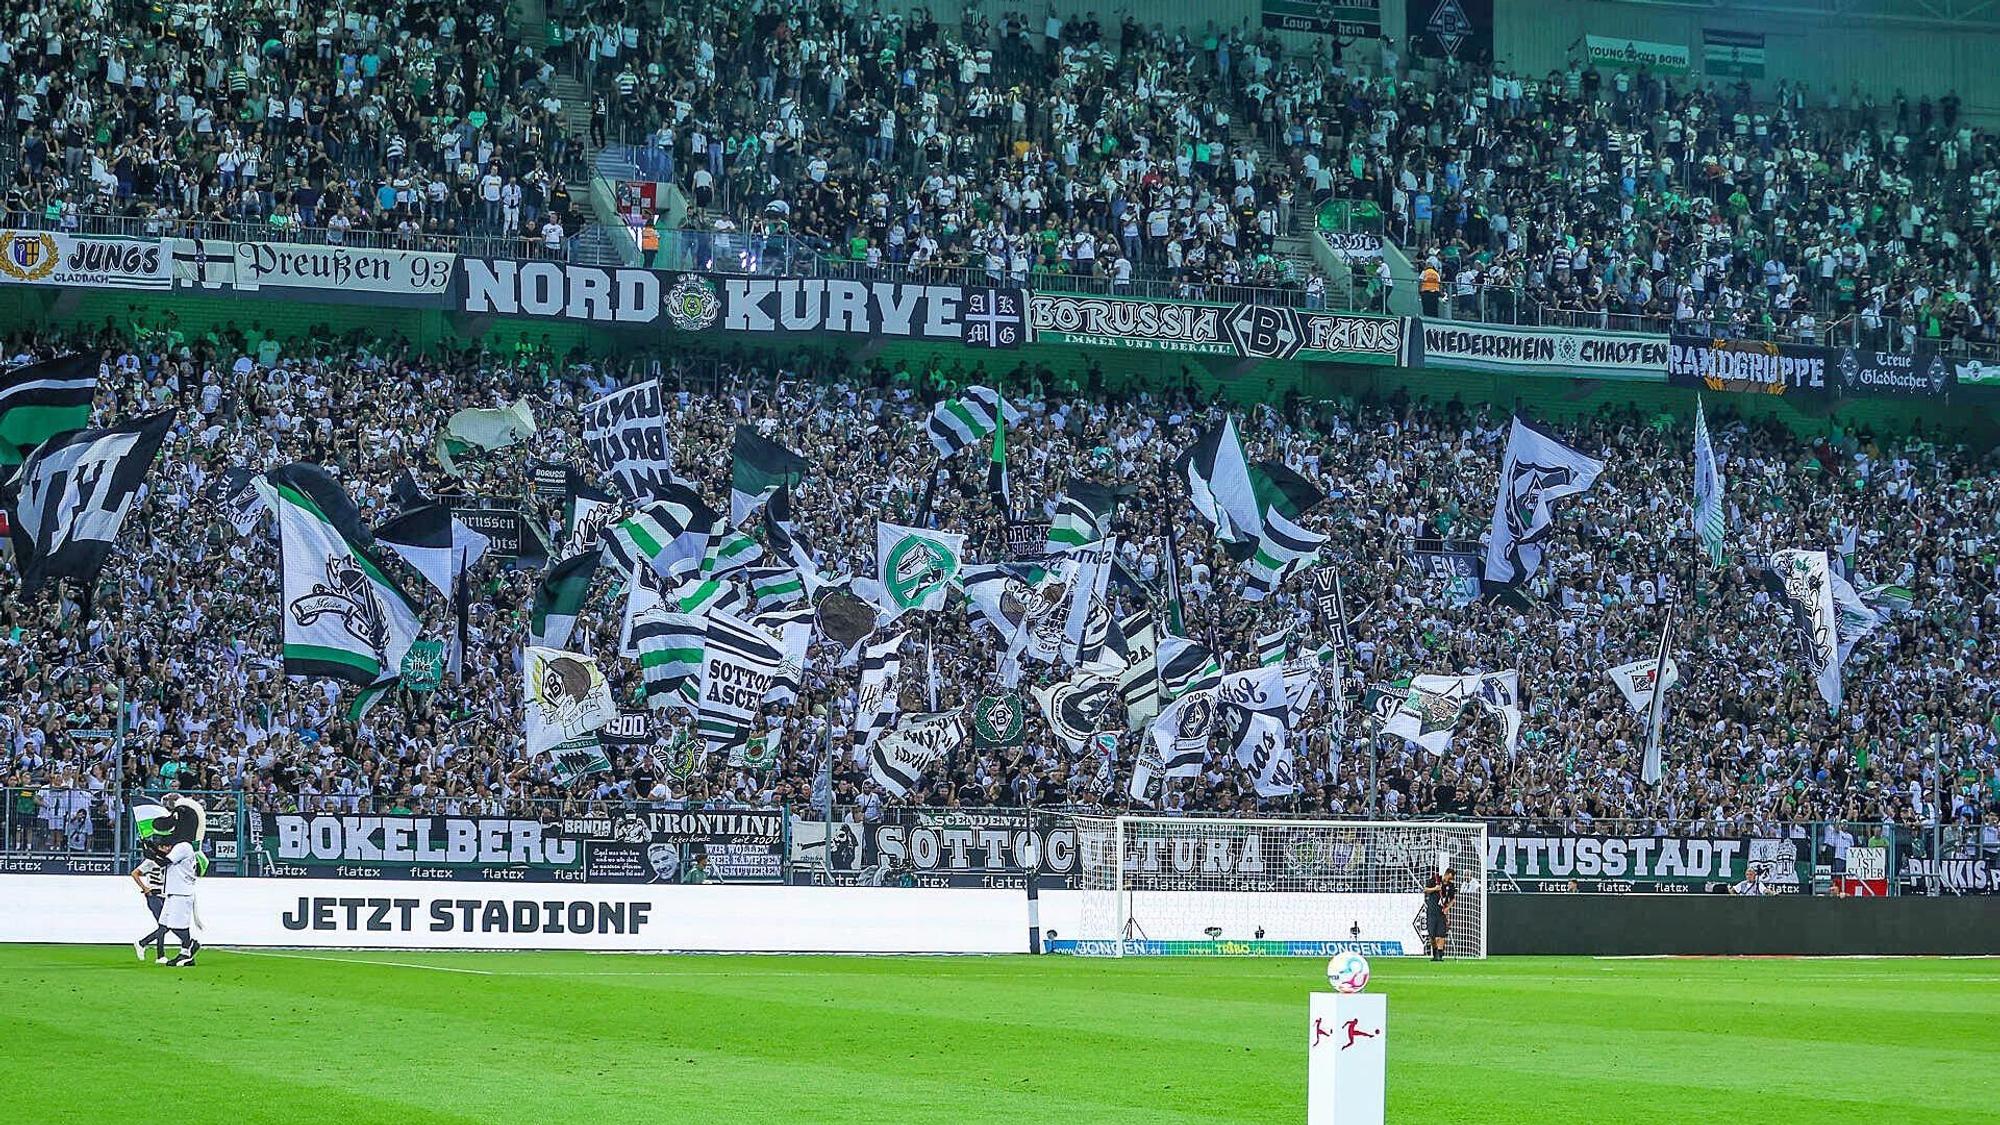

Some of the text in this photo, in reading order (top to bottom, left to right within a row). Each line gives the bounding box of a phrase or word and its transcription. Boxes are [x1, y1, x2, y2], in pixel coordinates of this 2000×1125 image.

[68, 241, 160, 275] JUNGS
[238, 242, 390, 286] Preußen
[54, 274, 109, 284] GLADBACH
[463, 259, 962, 337] NORD KURVE
[1031, 297, 1219, 342] BORUSSIA
[1308, 316, 1400, 352] FANS
[1065, 335, 1117, 346] IMMER
[1125, 338, 1153, 349] UND
[1426, 329, 1668, 365] NIEDERRHEIN CHAOTEN
[1668, 344, 1825, 388] RANDGRUPPE
[1875, 351, 1911, 367] Treue
[1860, 369, 1928, 389] Gladbacher
[706, 682, 763, 712] ASCE
[565, 820, 611, 833] BANDA
[648, 813, 782, 837] FRONTLINE
[704, 844, 769, 854] WIR WOLLEN
[1850, 849, 1882, 858] YANN
[67, 861, 111, 872] flatex
[337, 865, 380, 877] flatex
[410, 866, 453, 878] flatex
[482, 867, 525, 879] flatex
[1858, 859, 1876, 867] IST
[1597, 882, 1632, 892] flatex
[1654, 883, 1688, 893] flatex
[283, 897, 652, 934] JETZT STADIONF
